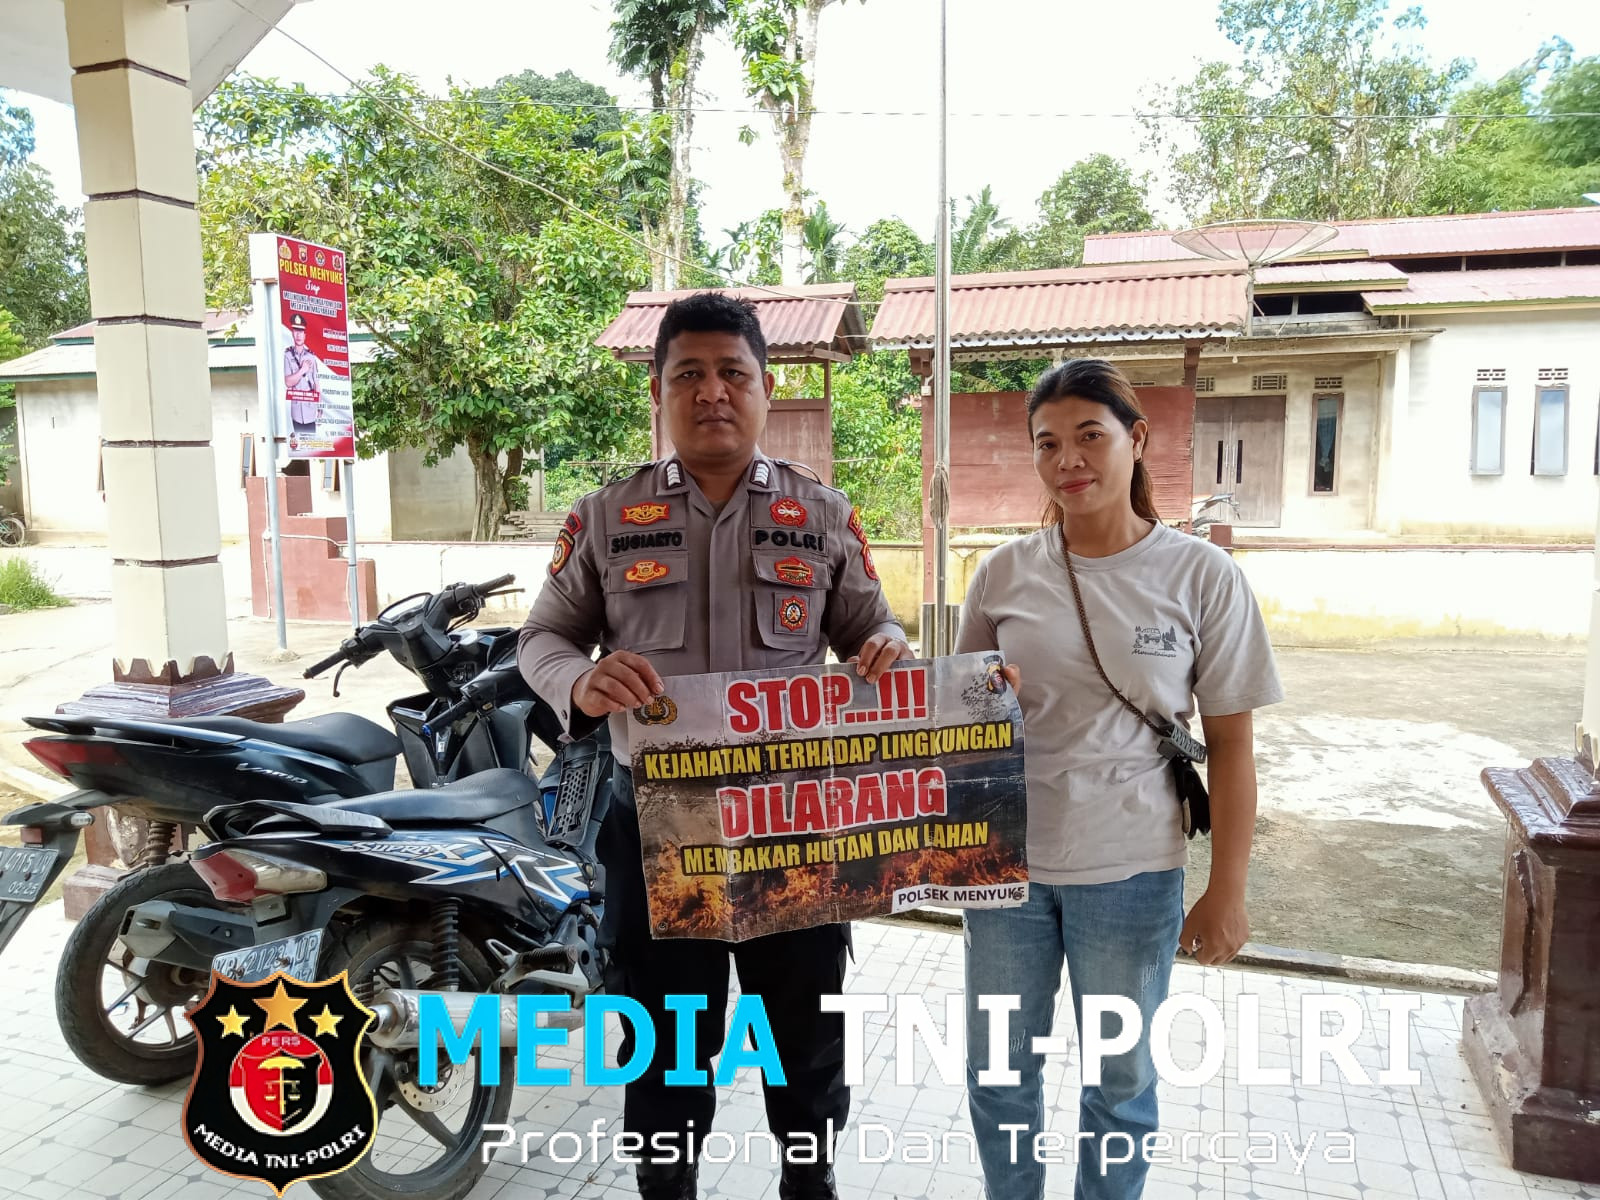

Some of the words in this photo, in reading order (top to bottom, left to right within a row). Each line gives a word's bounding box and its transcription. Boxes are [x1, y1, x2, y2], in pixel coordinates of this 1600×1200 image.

[279, 258, 308, 277] POLSEK
[309, 265, 344, 285] MENYUKE
[610, 530, 683, 554] SUGIARTO
[755, 529, 825, 553] POLRI
[644, 747, 761, 780] KEJAHATAN
[765, 735, 877, 771] TERHADAP
[881, 722, 1013, 760] LINGKUNGAN
[717, 768, 947, 840] DILARANG
[807, 835, 873, 864] HUTAN
[877, 829, 917, 854] DAN
[923, 822, 989, 848] LAHAN
[897, 887, 949, 906] POLSEK
[294, 934, 319, 966] UP
